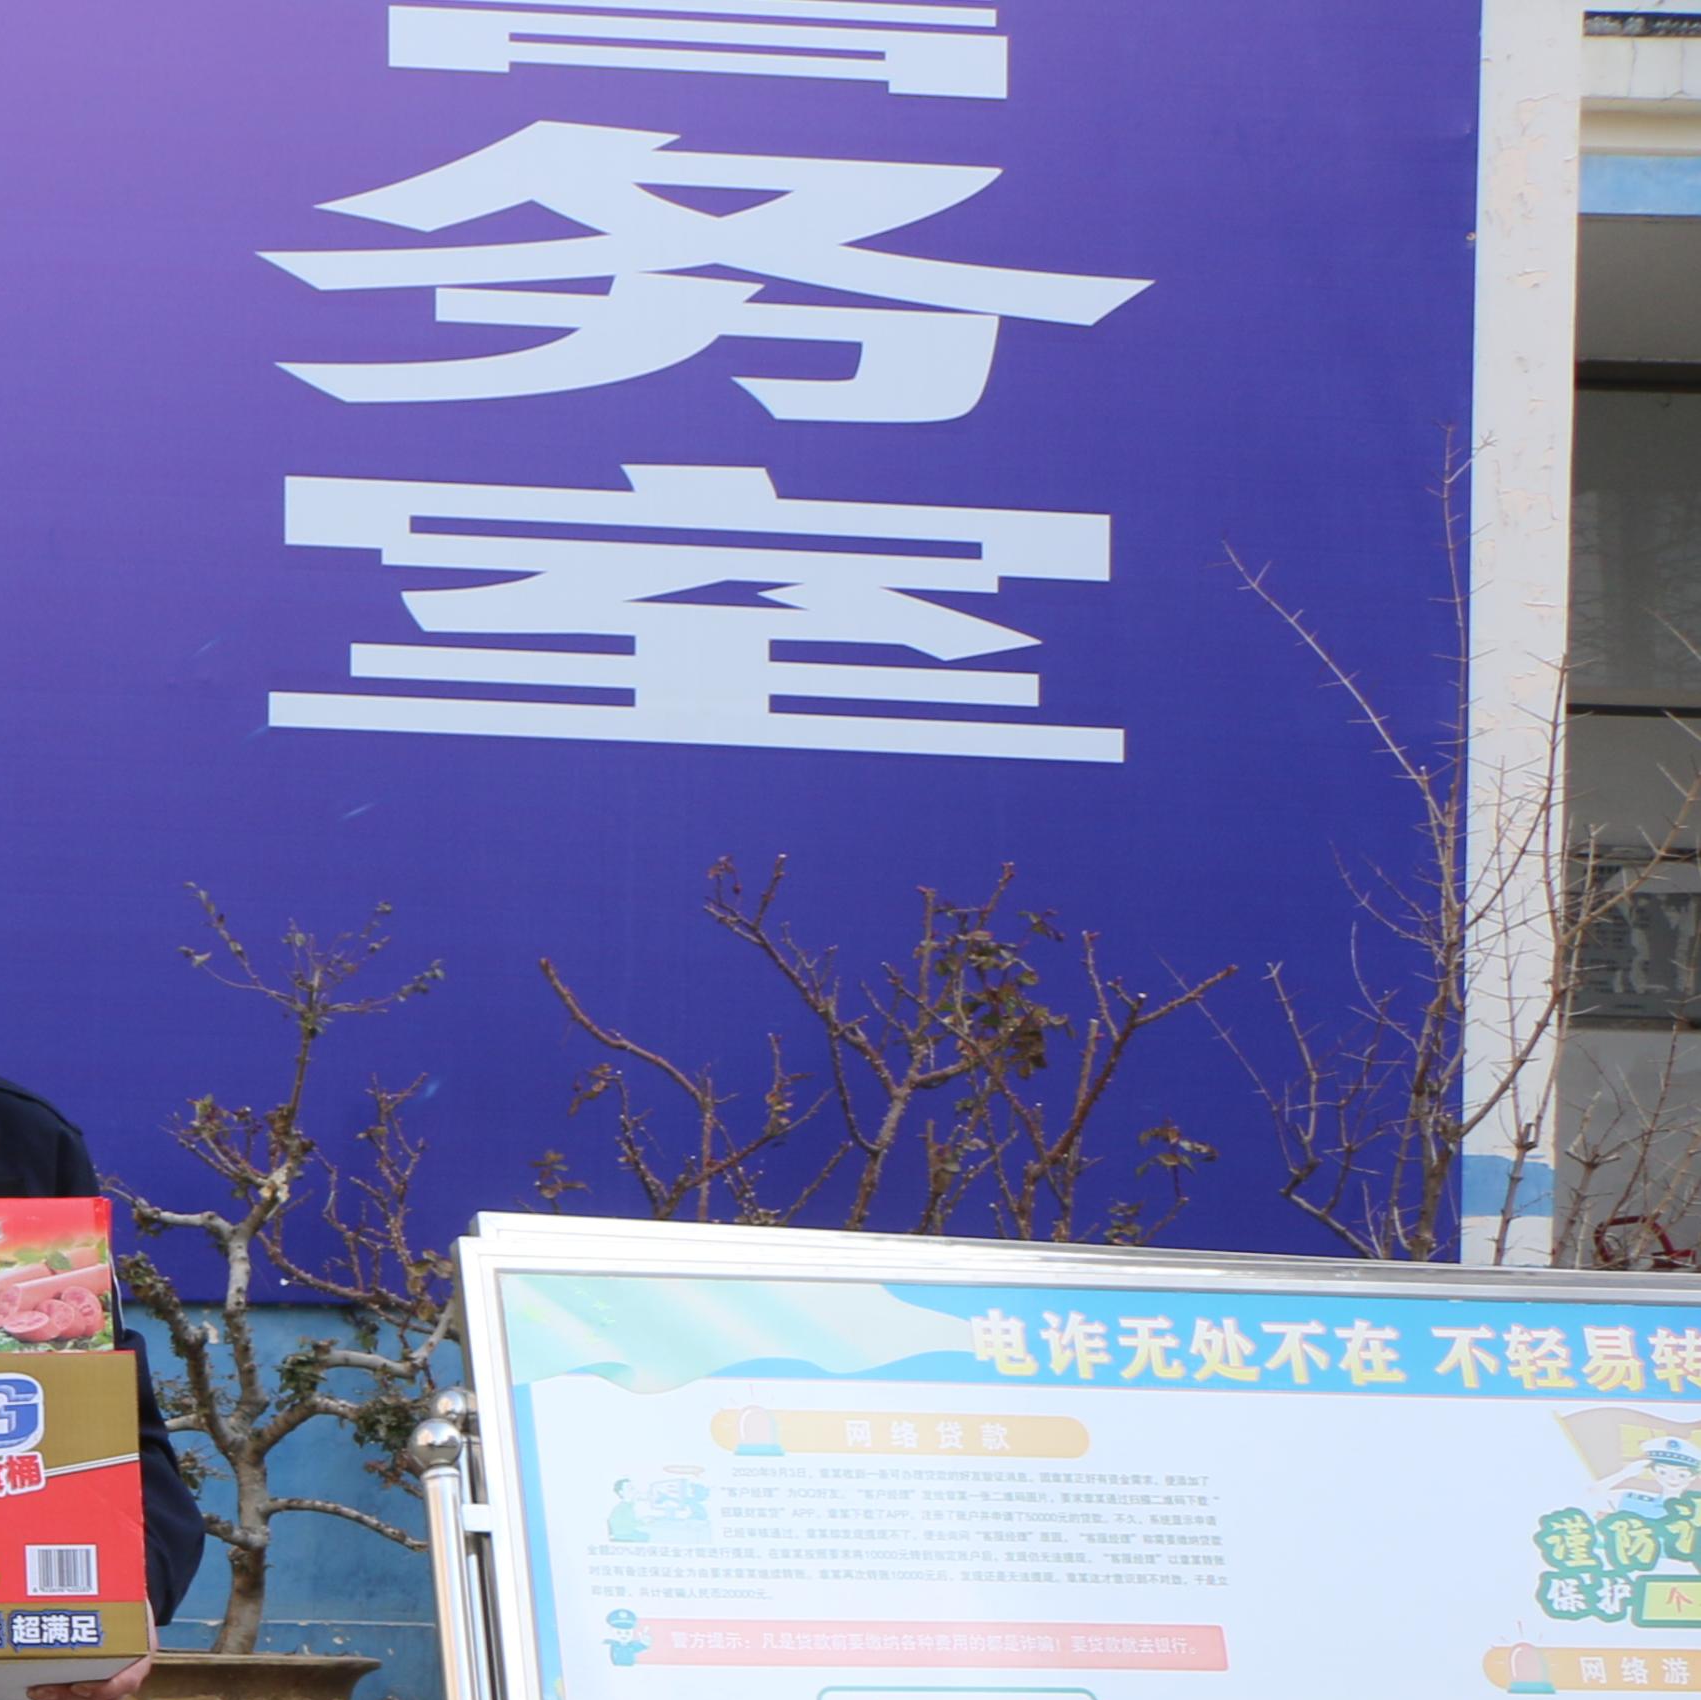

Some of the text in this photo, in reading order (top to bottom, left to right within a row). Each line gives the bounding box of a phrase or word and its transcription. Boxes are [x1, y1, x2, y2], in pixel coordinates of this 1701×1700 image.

[971, 1309, 1701, 1393] 电诈无处不在 不轻易转
[844, 1418, 1012, 1450] 网络贷款
[1547, 1574, 1631, 1614] 保护
[11, 1613, 99, 1645] 超满足
[1579, 1655, 1691, 1685] 网络游
